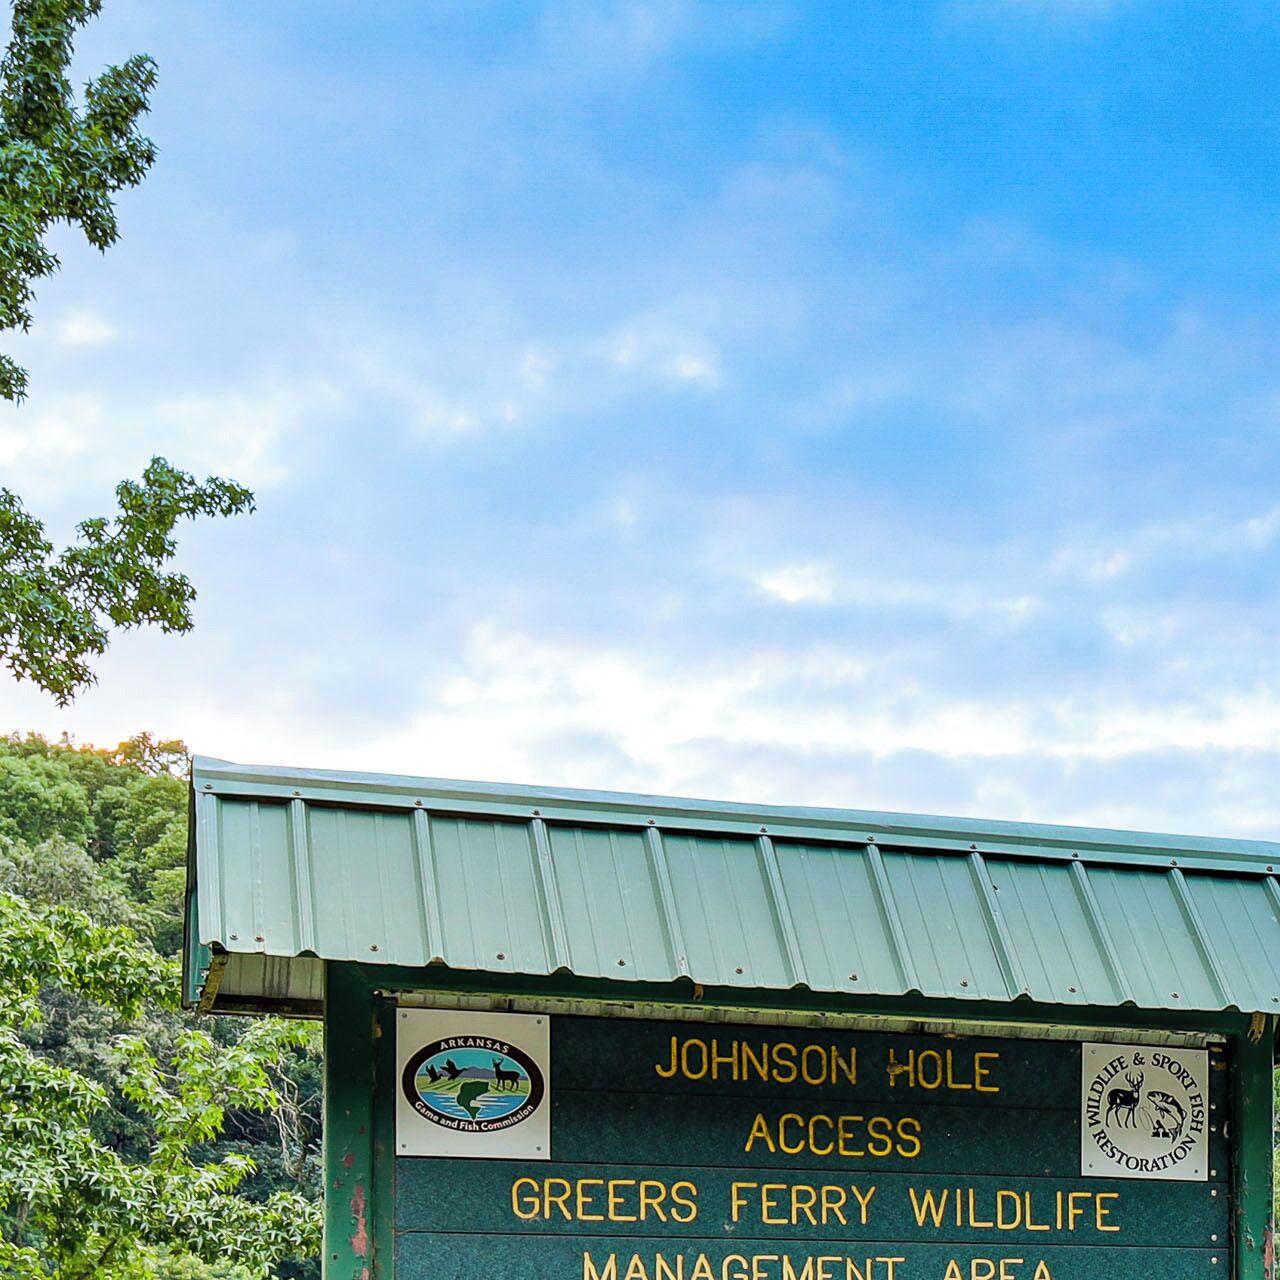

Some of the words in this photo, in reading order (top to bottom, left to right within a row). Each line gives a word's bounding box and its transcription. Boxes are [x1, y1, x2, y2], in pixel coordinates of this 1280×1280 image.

[440, 1037, 510, 1054] ARKANSAS
[655, 1036, 857, 1085] JOHNSON
[888, 1049, 1000, 1092] HOLE
[1087, 1055, 1129, 1127] WILDLIFE
[1132, 1052, 1145, 1066] &
[1151, 1052, 1198, 1090] SPORT
[1188, 1092, 1205, 1134] FISH
[415, 1101, 438, 1121] Game
[439, 1116, 459, 1129] and
[459, 1121, 480, 1131] Fish
[481, 1105, 534, 1131] Commission
[744, 1113, 922, 1158] ACCESS
[1093, 1129, 1196, 1172] RESTORATION
[511, 1177, 698, 1223] GREERS
[730, 1181, 877, 1227] FERRY
[908, 1187, 1121, 1232] WILDLIFE
